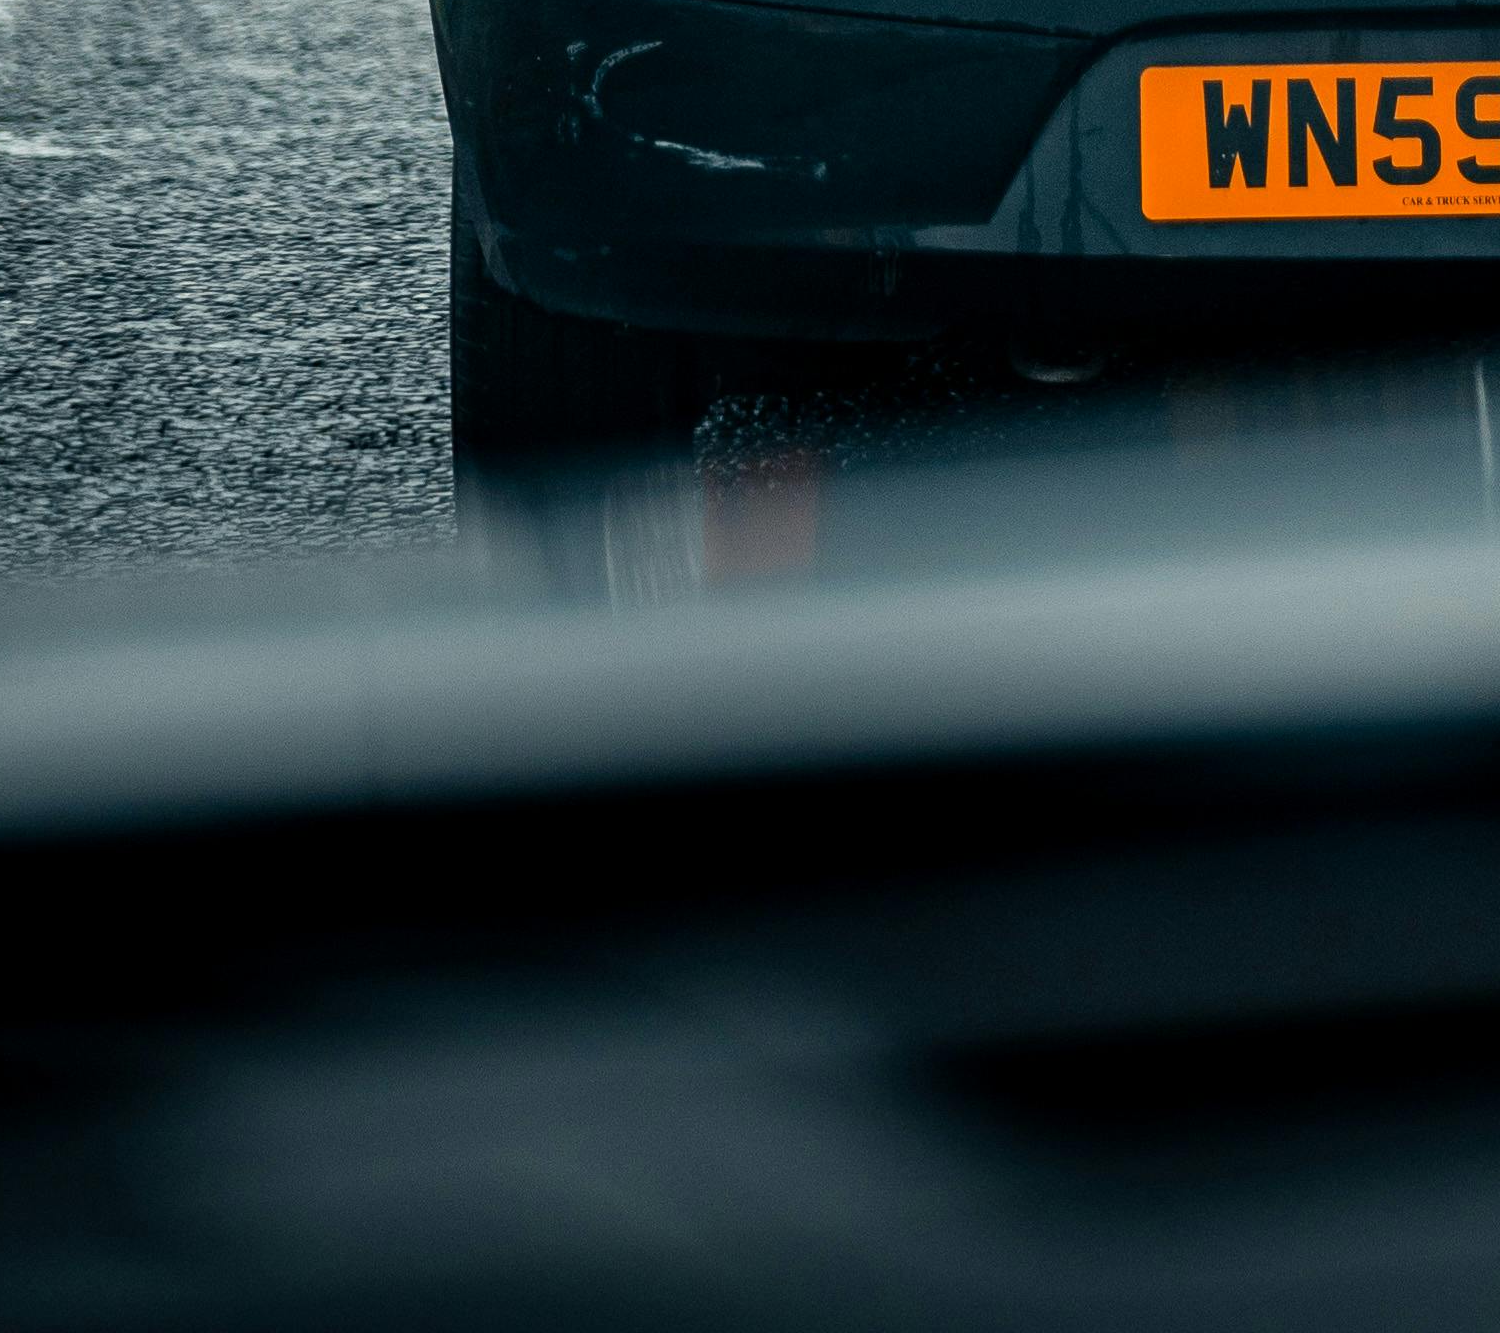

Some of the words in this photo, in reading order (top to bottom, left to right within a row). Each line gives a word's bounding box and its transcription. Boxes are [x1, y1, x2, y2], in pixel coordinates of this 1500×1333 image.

[1402, 196, 1423, 206] CAR
[1425, 197, 1432, 205] &
[1435, 196, 1470, 206] TRUCK
